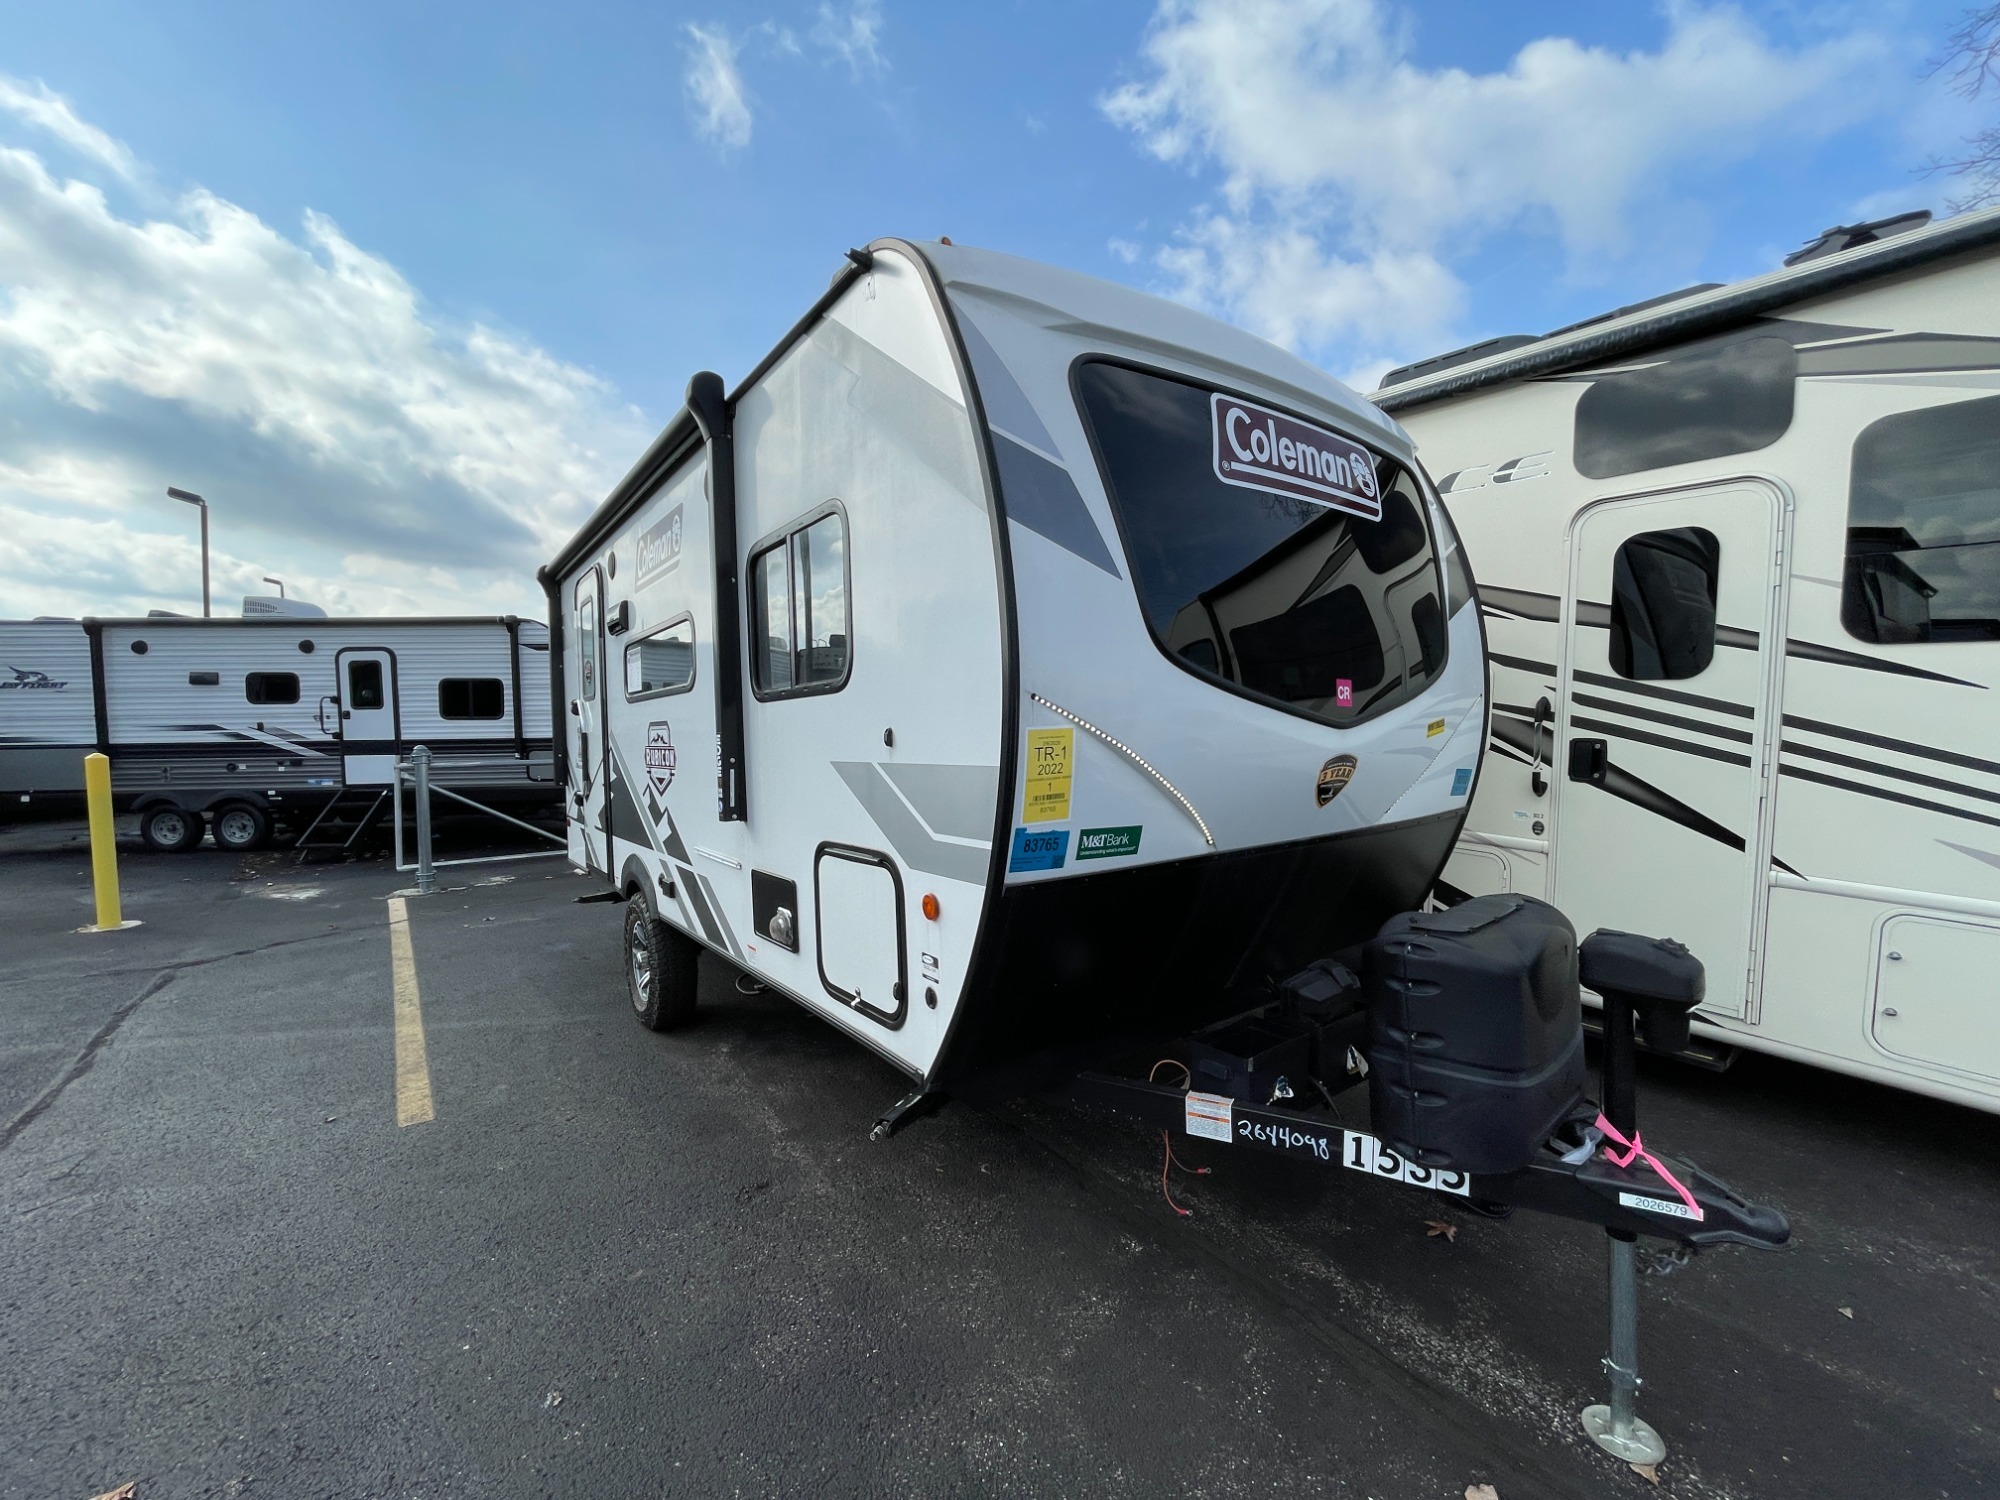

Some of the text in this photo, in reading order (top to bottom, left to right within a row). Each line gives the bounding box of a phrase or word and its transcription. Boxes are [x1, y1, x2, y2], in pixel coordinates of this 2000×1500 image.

[1225, 407, 1353, 488] Coleman
[637, 529, 672, 579] Coleman
[1337, 685, 1350, 700] CR
[645, 748, 675, 767] RUBICON
[1034, 746, 1066, 761] TR-1
[1038, 763, 1063, 775] 2022
[1320, 767, 1353, 783] 3 YEAR
[1047, 781, 1052, 792] 1
[1024, 838, 1059, 852] 83765
[1081, 833, 1129, 849] M&T Bank
[1237, 1119, 1330, 1160] 2644098
[1635, 1197, 1688, 1216] 2026579
